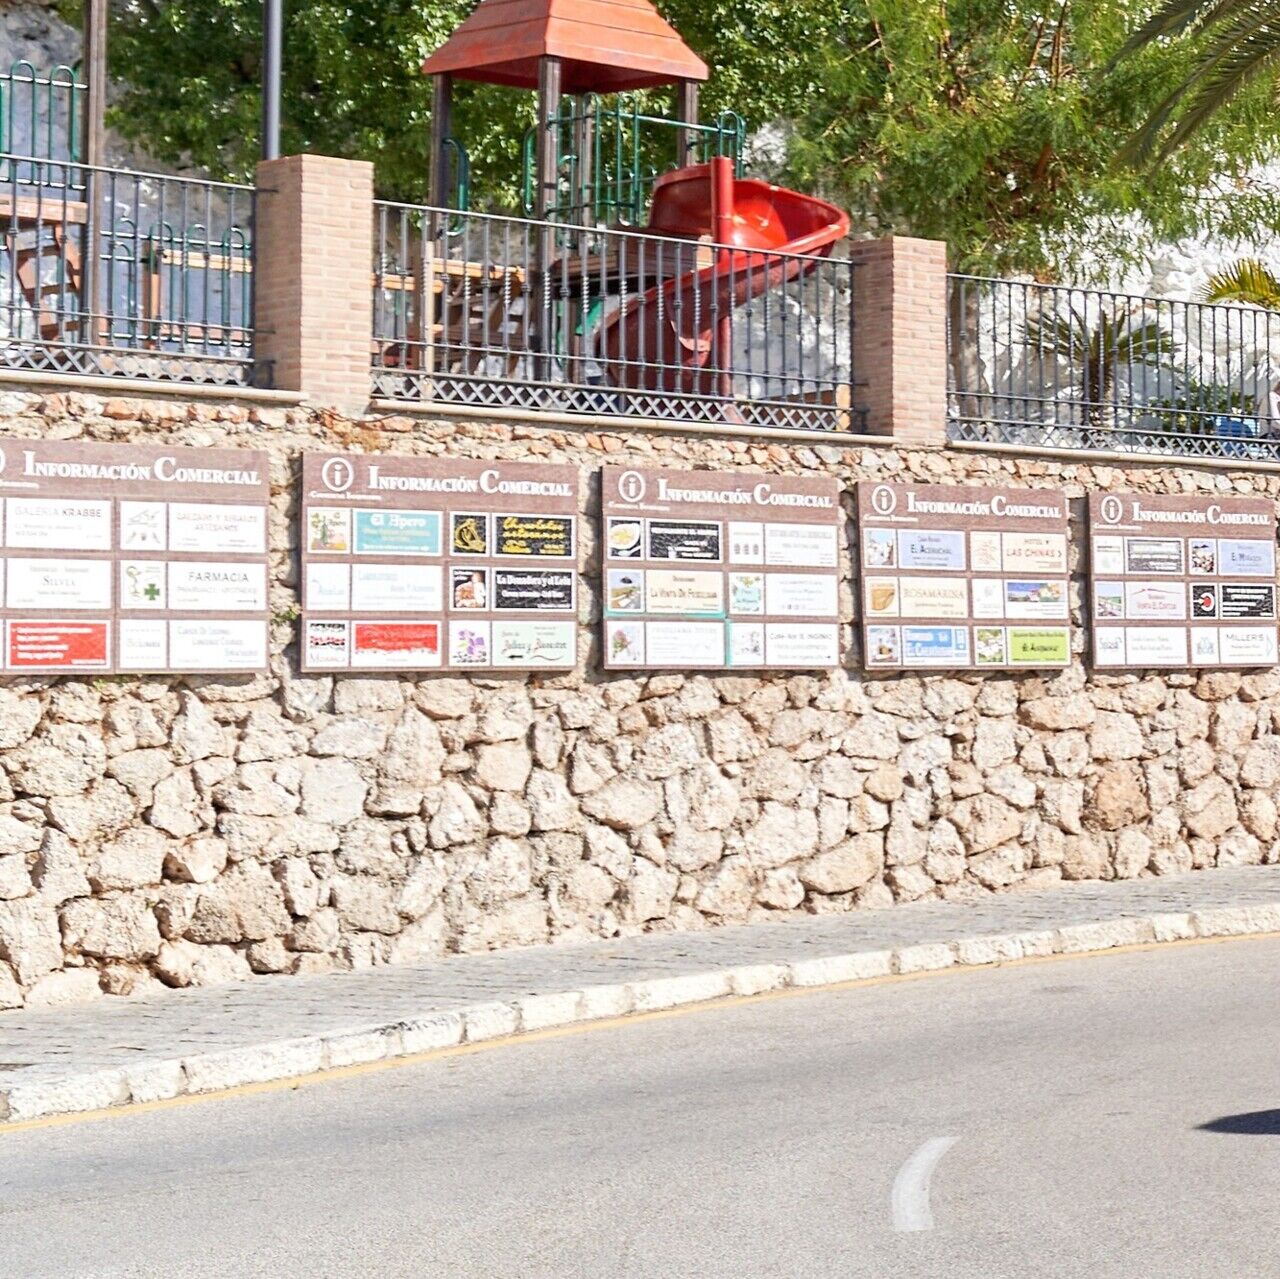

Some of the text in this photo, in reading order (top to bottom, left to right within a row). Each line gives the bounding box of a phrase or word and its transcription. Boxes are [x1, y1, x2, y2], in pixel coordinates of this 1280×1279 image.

[23, 451, 261, 485] INFORMACIÓN COMERCIAL
[367, 465, 572, 496] INFORMACIÓN COMERCIAL
[657, 478, 833, 508] INFORMACIÓN COMERCIAL
[906, 491, 1062, 518] INFORMACIÓN COMERCIAL
[1131, 502, 1271, 526] INFORMACIÓN COMERCIAL
[188, 571, 249, 582] FARMACIA
